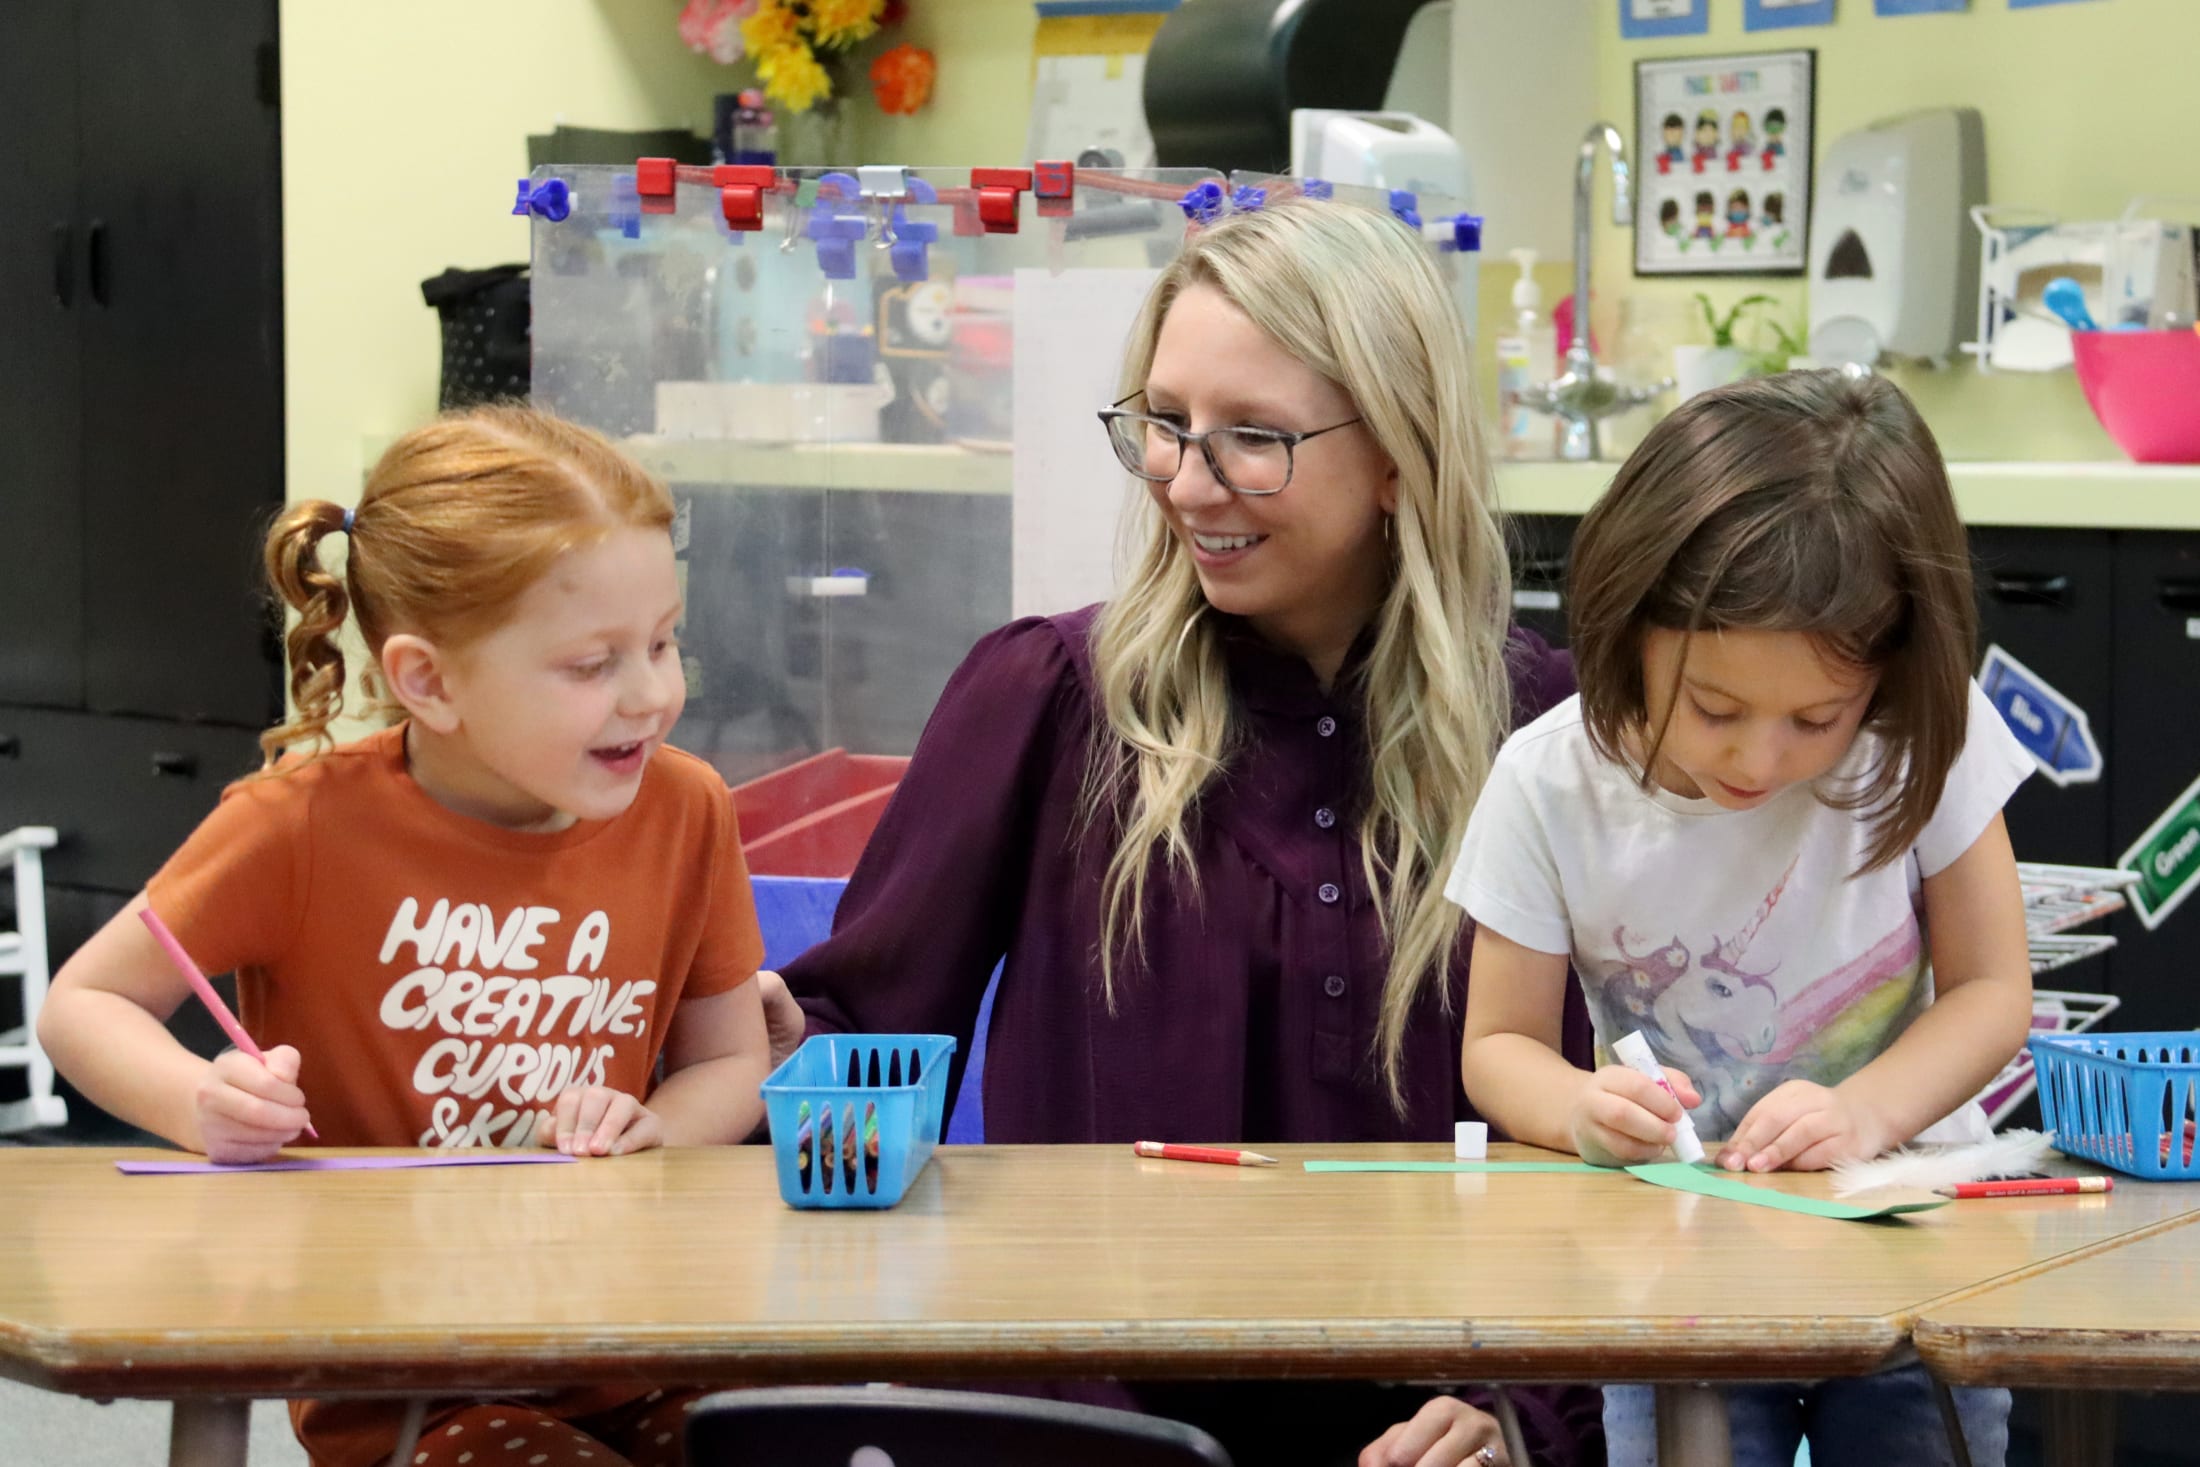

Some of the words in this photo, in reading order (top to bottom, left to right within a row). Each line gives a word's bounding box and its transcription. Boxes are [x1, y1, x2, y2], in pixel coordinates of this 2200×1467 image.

[379, 897, 560, 970] HAVE
[567, 910, 610, 973] A
[379, 967, 657, 1037] CREATIVE,
